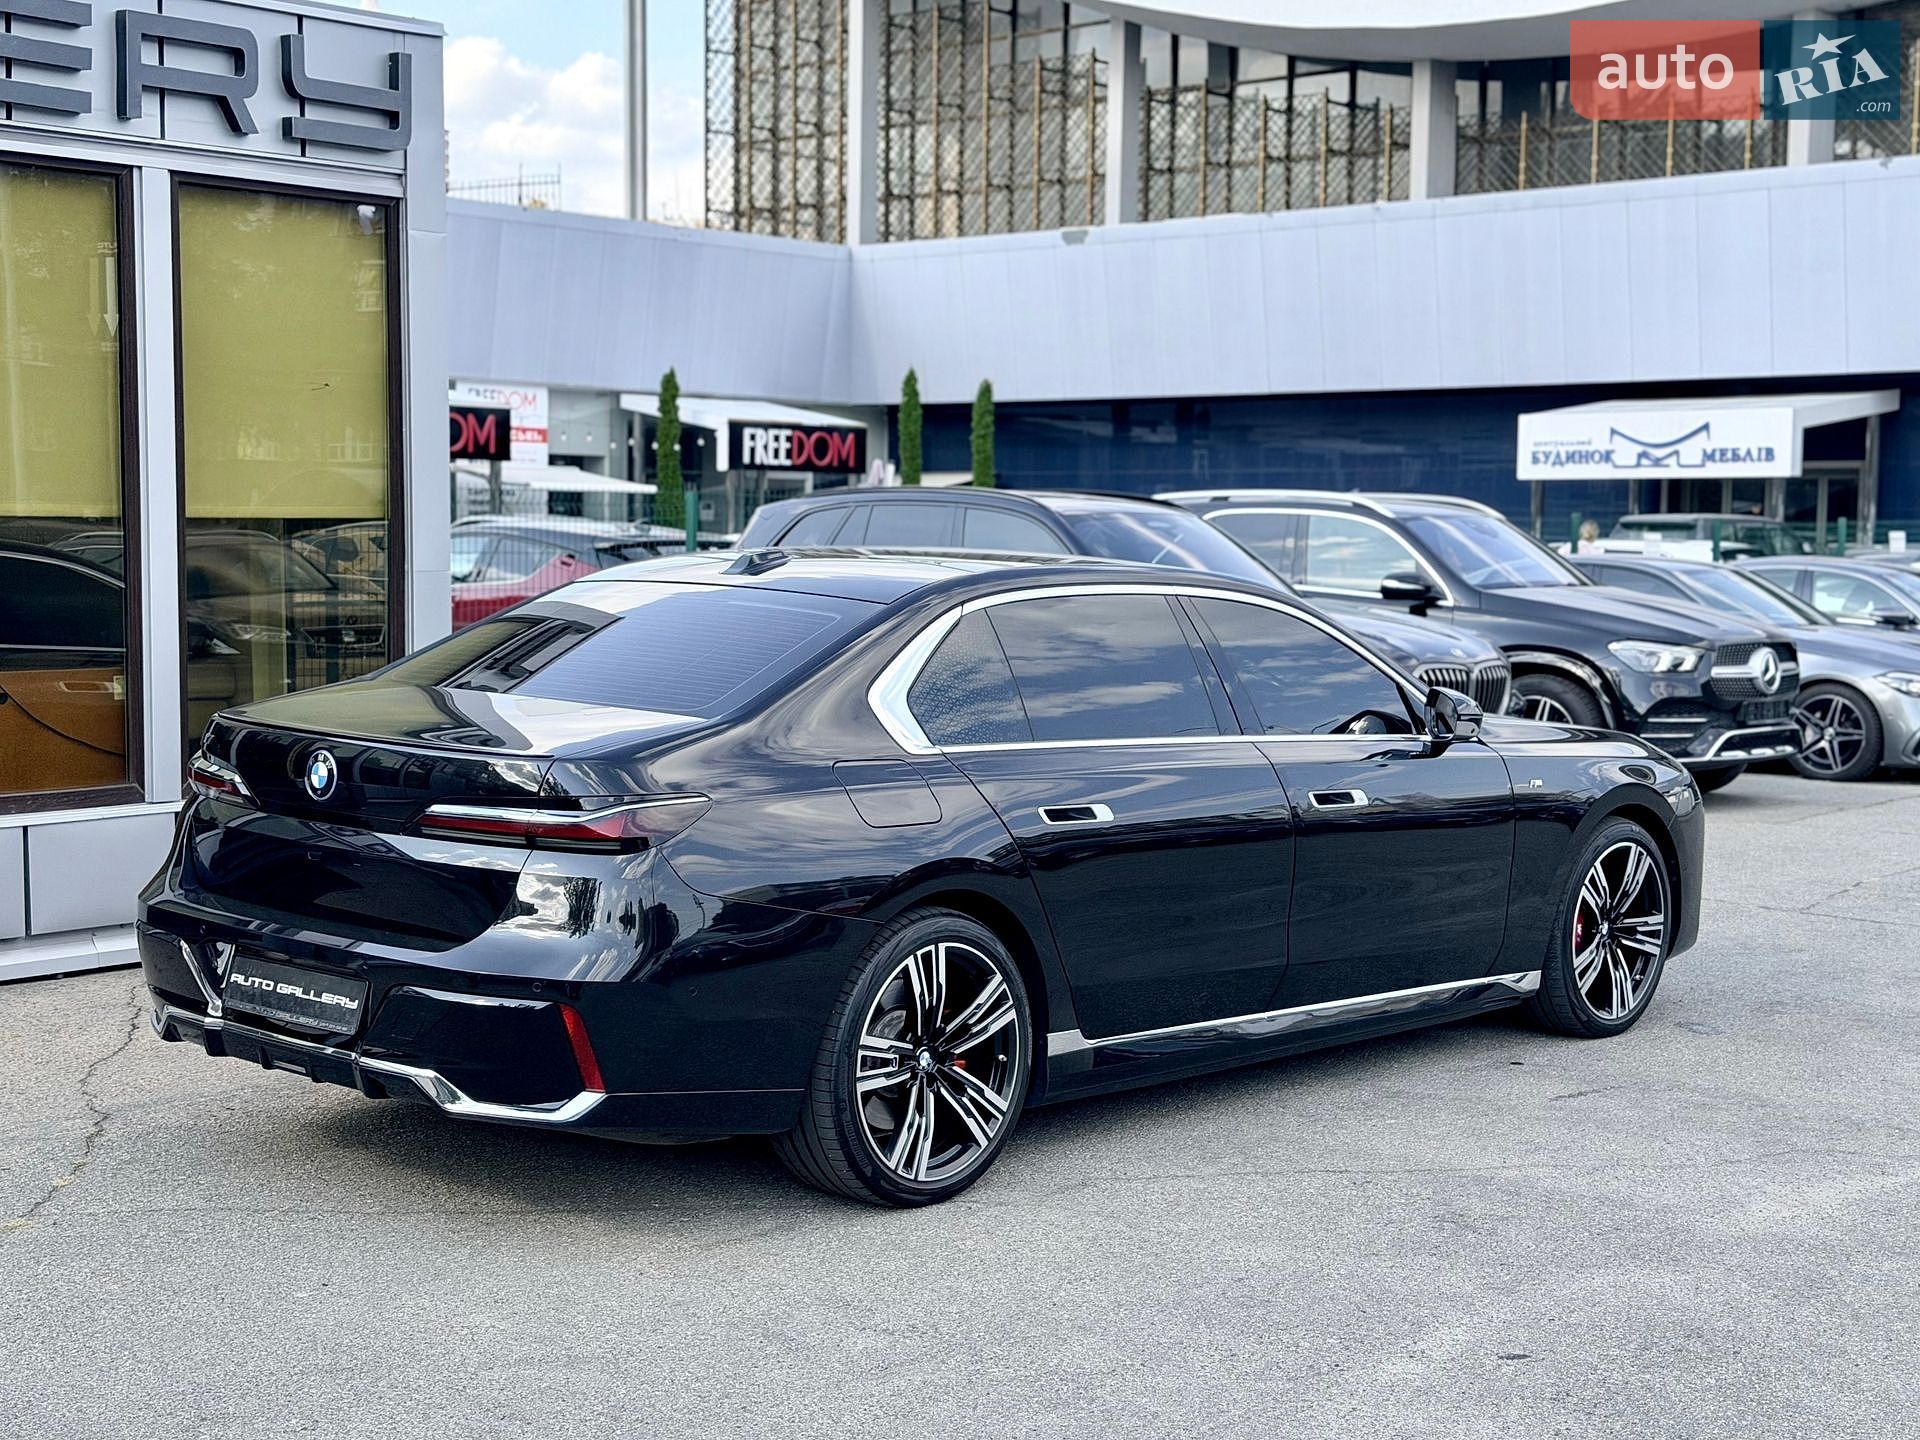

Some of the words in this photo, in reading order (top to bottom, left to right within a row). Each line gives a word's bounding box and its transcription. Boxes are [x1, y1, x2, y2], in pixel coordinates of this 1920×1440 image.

[742, 426, 856, 468] FREEDOM
[1531, 449, 1616, 467] БУДИНОК
[1701, 447, 1776, 467] МЕБЛІВ
[230, 973, 275, 991] AUTO
[276, 983, 359, 1010] GALLERY
